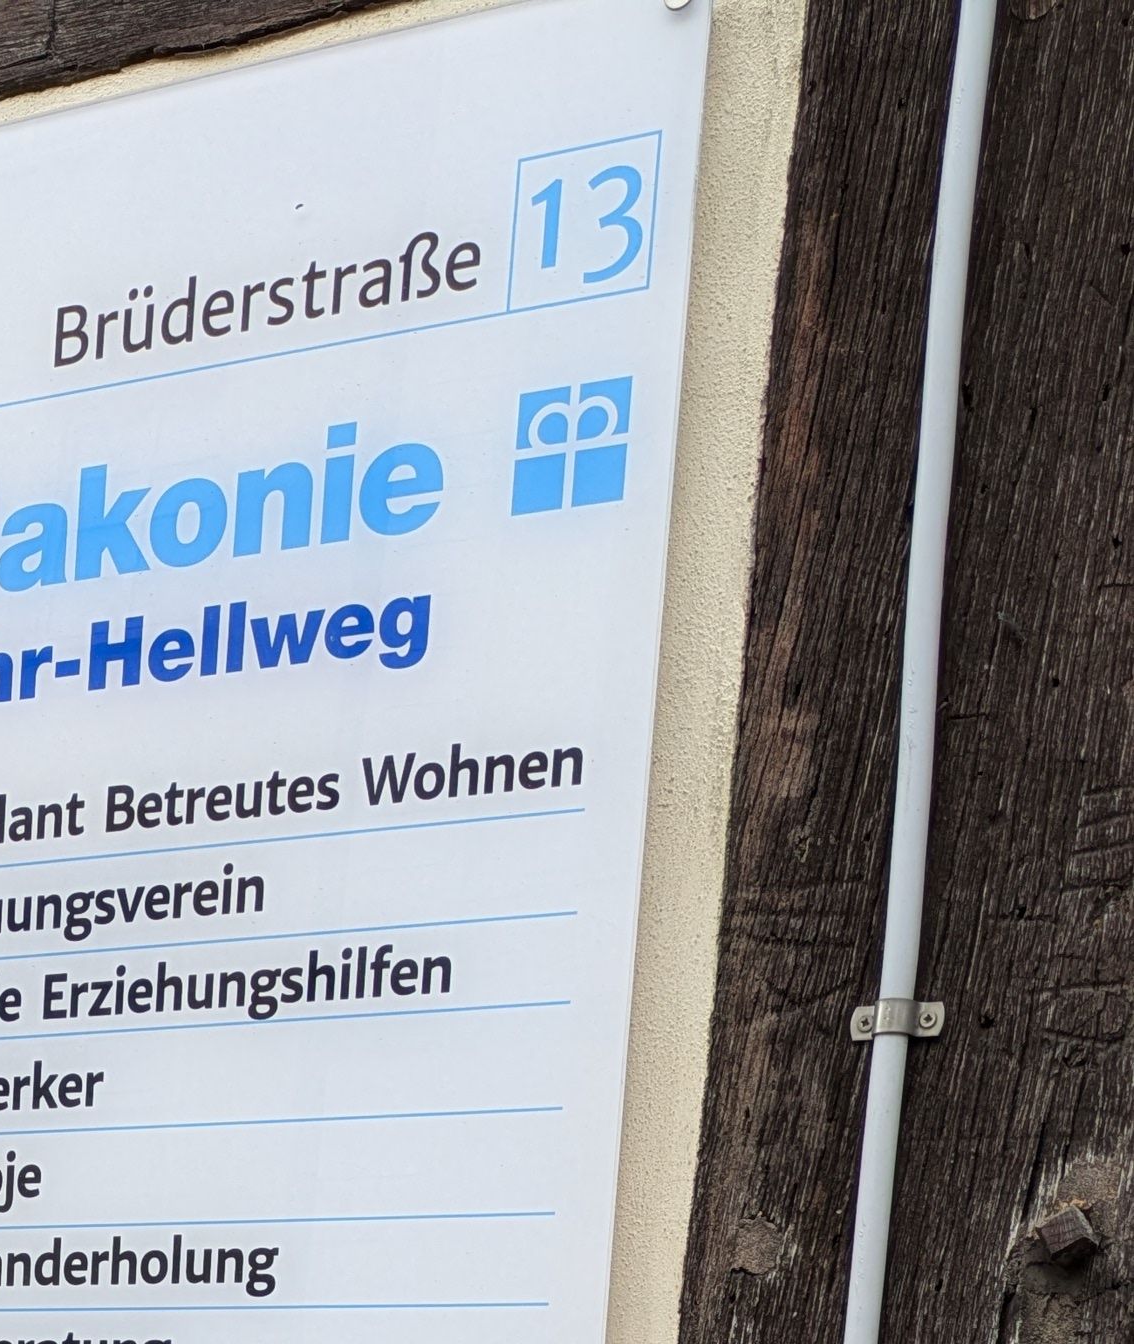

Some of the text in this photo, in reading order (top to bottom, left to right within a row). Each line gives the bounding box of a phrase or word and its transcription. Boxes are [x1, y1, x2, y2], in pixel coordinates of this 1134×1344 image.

[54, 165, 645, 367] Brüderstraße 13
[105, 770, 340, 832] Betreutes
[362, 744, 584, 806] Wohnen
[42, 945, 452, 1020] Erziehungshilfen
